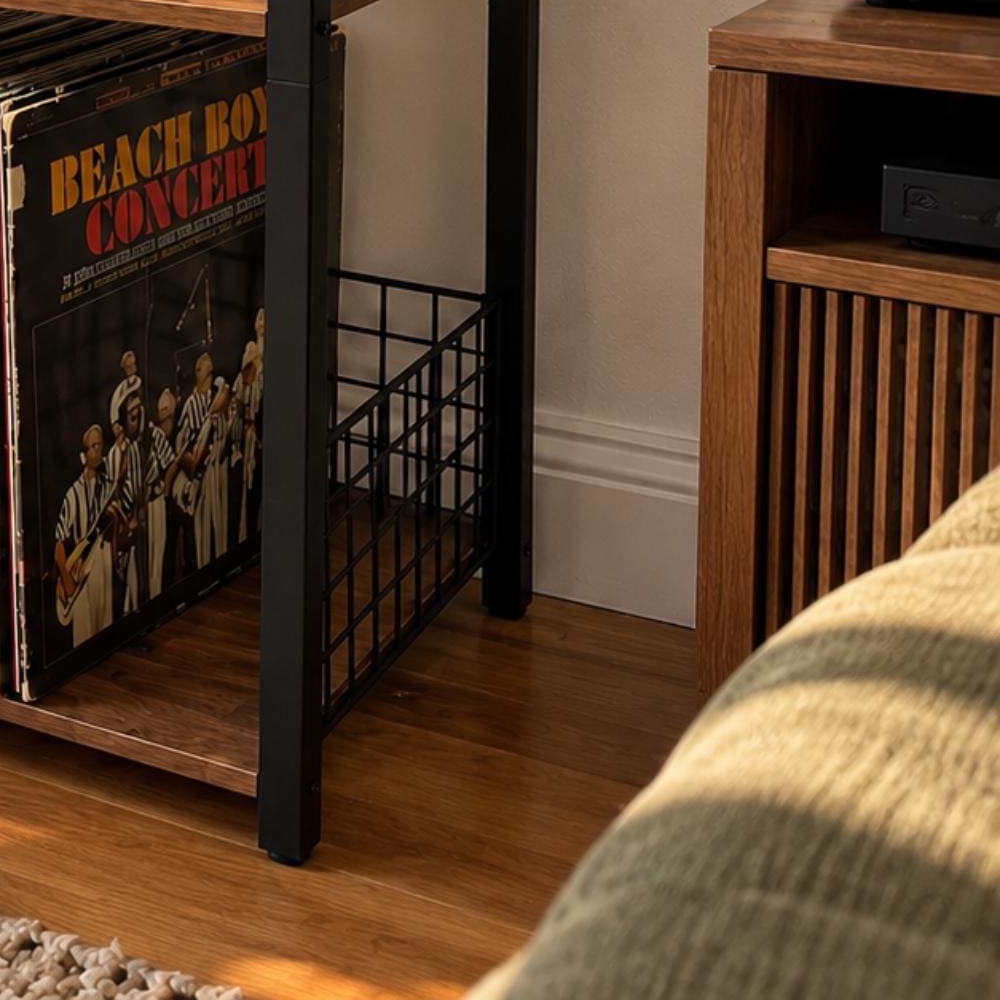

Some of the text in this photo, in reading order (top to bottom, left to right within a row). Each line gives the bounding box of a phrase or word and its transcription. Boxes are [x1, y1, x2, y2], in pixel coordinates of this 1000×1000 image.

[50, 86, 267, 216] BEACH BOY
[85, 138, 267, 257] CONCERT
